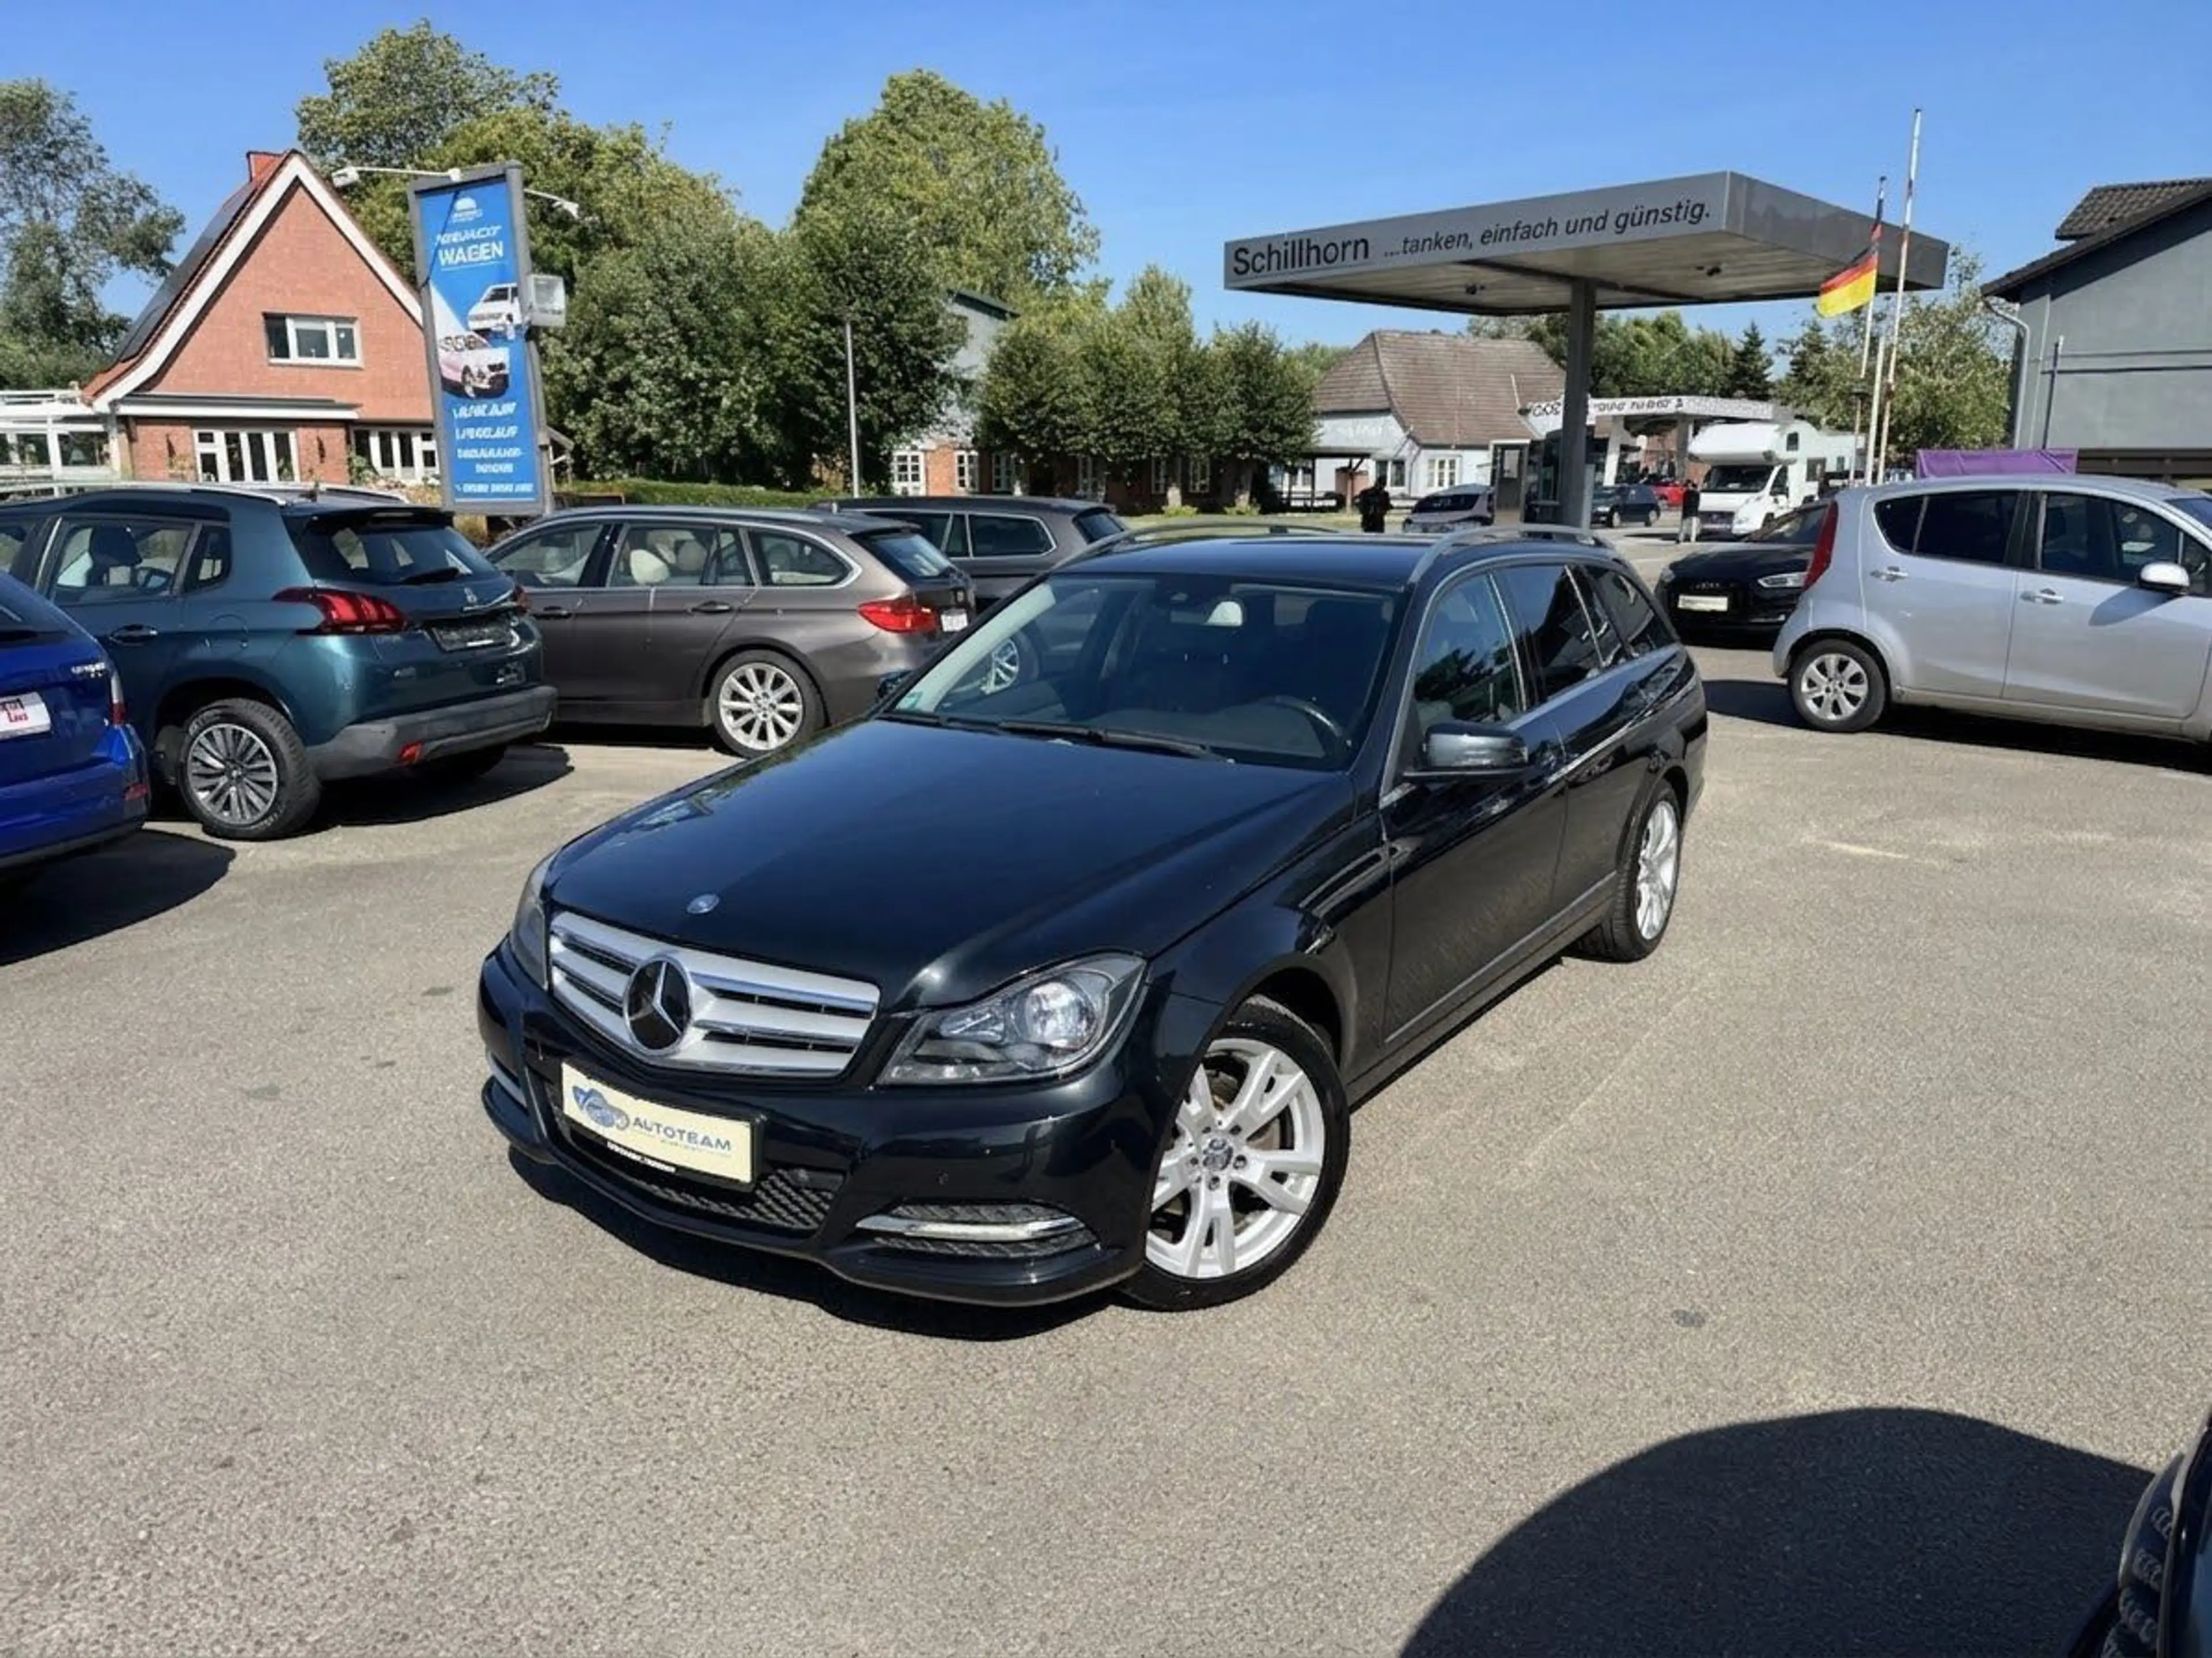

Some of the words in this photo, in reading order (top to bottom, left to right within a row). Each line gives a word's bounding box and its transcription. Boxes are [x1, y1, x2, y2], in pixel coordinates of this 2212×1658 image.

[1233, 237, 1369, 276] Schillhorn
[1480, 216, 1558, 245] einfach
[1566, 210, 1609, 235] und
[1614, 199, 1710, 234] günstig.
[633, 1117, 732, 1151] AUTOTEAM
